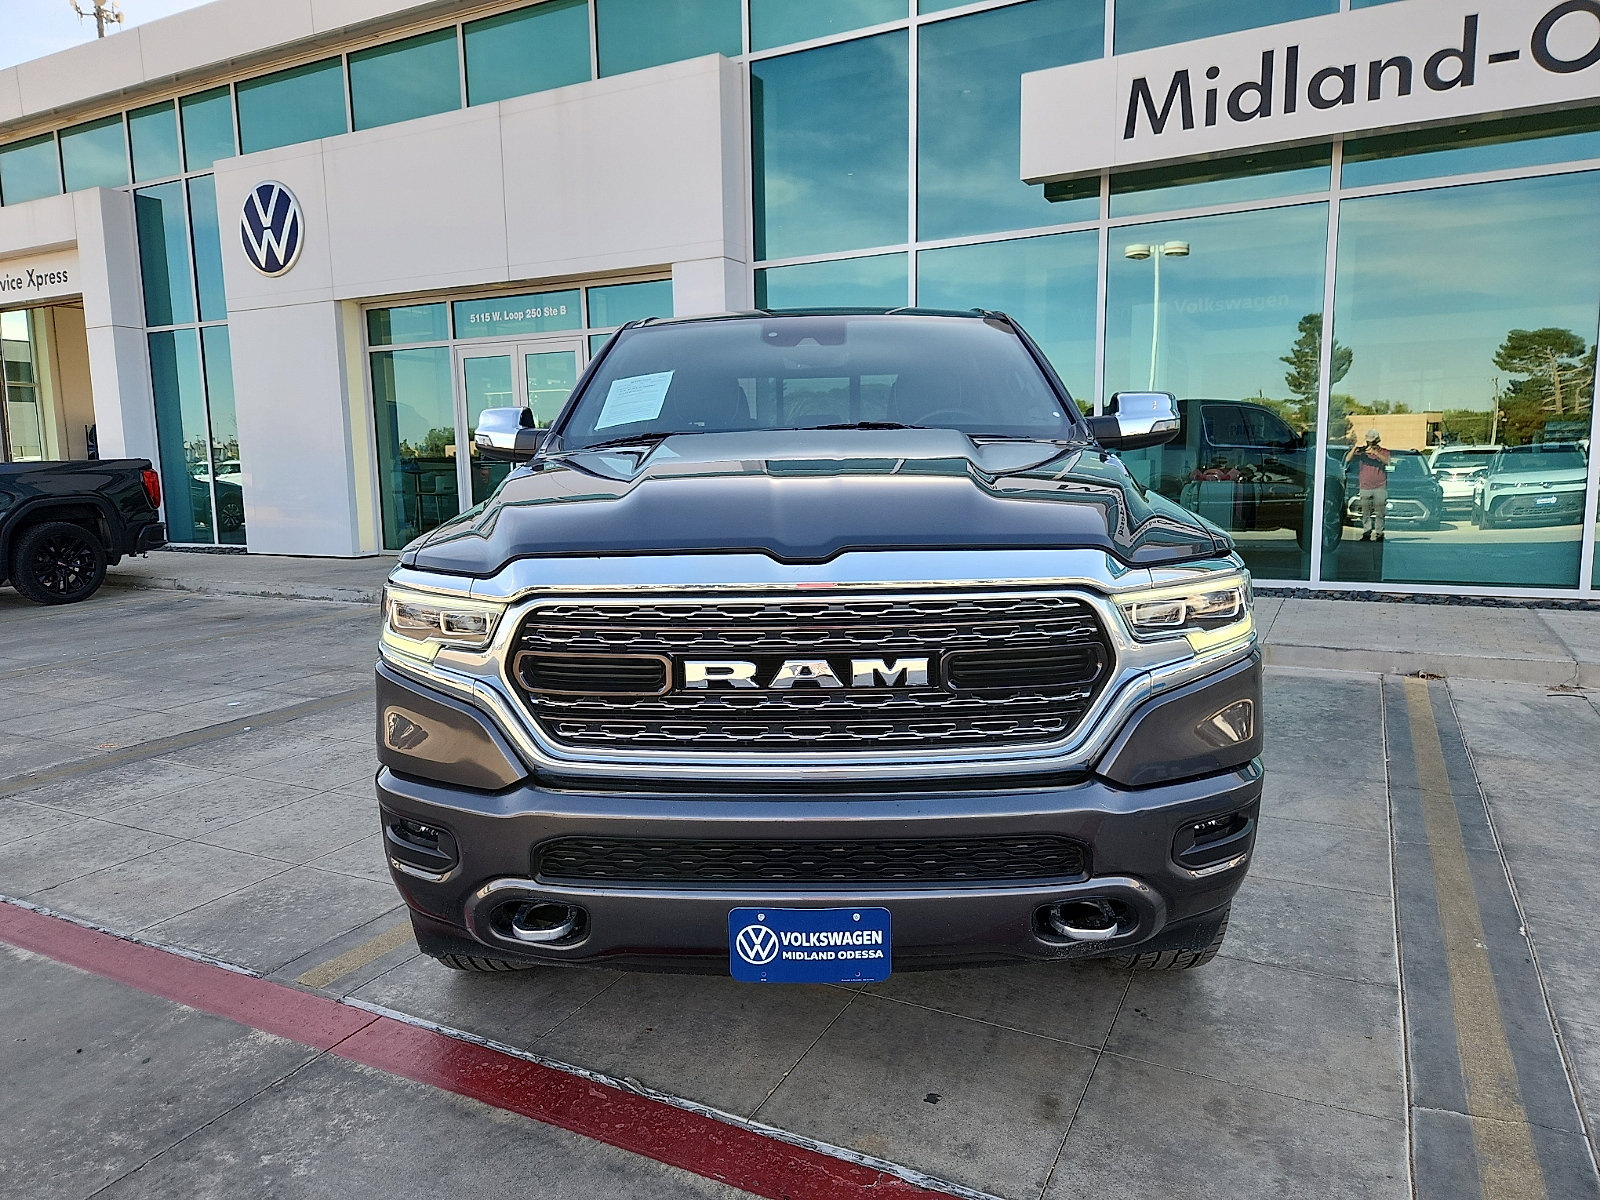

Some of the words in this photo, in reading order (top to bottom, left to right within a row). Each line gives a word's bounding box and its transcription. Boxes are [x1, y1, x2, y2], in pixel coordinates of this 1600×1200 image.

[26, 268, 68, 291] Xpress
[1174, 294, 1290, 313] Volkswagen
[470, 313, 491, 323] 5115
[492, 312, 503, 321] W.
[504, 310, 524, 321] Loop
[526, 308, 542, 318] 250
[543, 306, 558, 316] Ste
[560, 305, 567, 315] B
[684, 657, 929, 688] RAM
[780, 930, 883, 947] VOLKSWAGEN
[782, 950, 835, 961] MIDLAND
[837, 949, 884, 960] ODESSA
